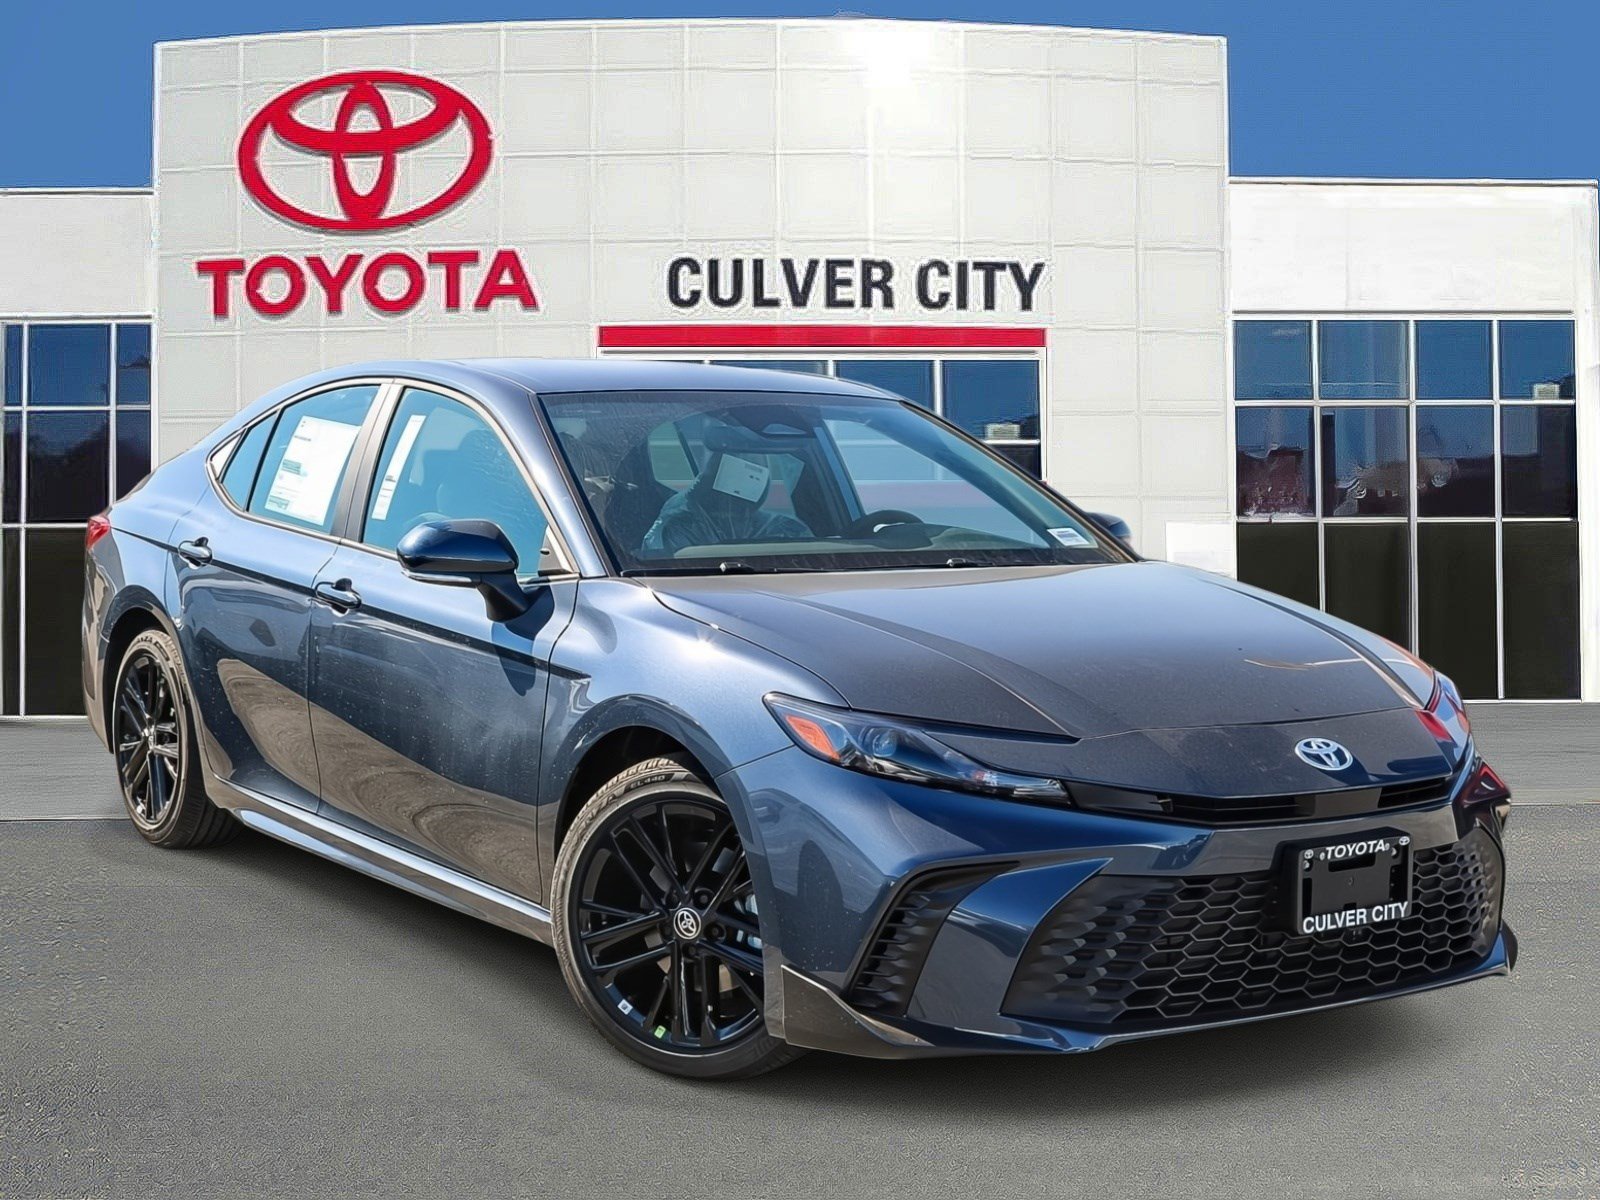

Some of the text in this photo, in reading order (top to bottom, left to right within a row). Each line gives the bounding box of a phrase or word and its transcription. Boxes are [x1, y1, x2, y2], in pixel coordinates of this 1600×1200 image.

[195, 249, 539, 316] TOYOTA
[667, 256, 1046, 312] CULVER CITY
[1325, 839, 1386, 860] TOYOTA
[1302, 901, 1409, 934] CULVER CITY
